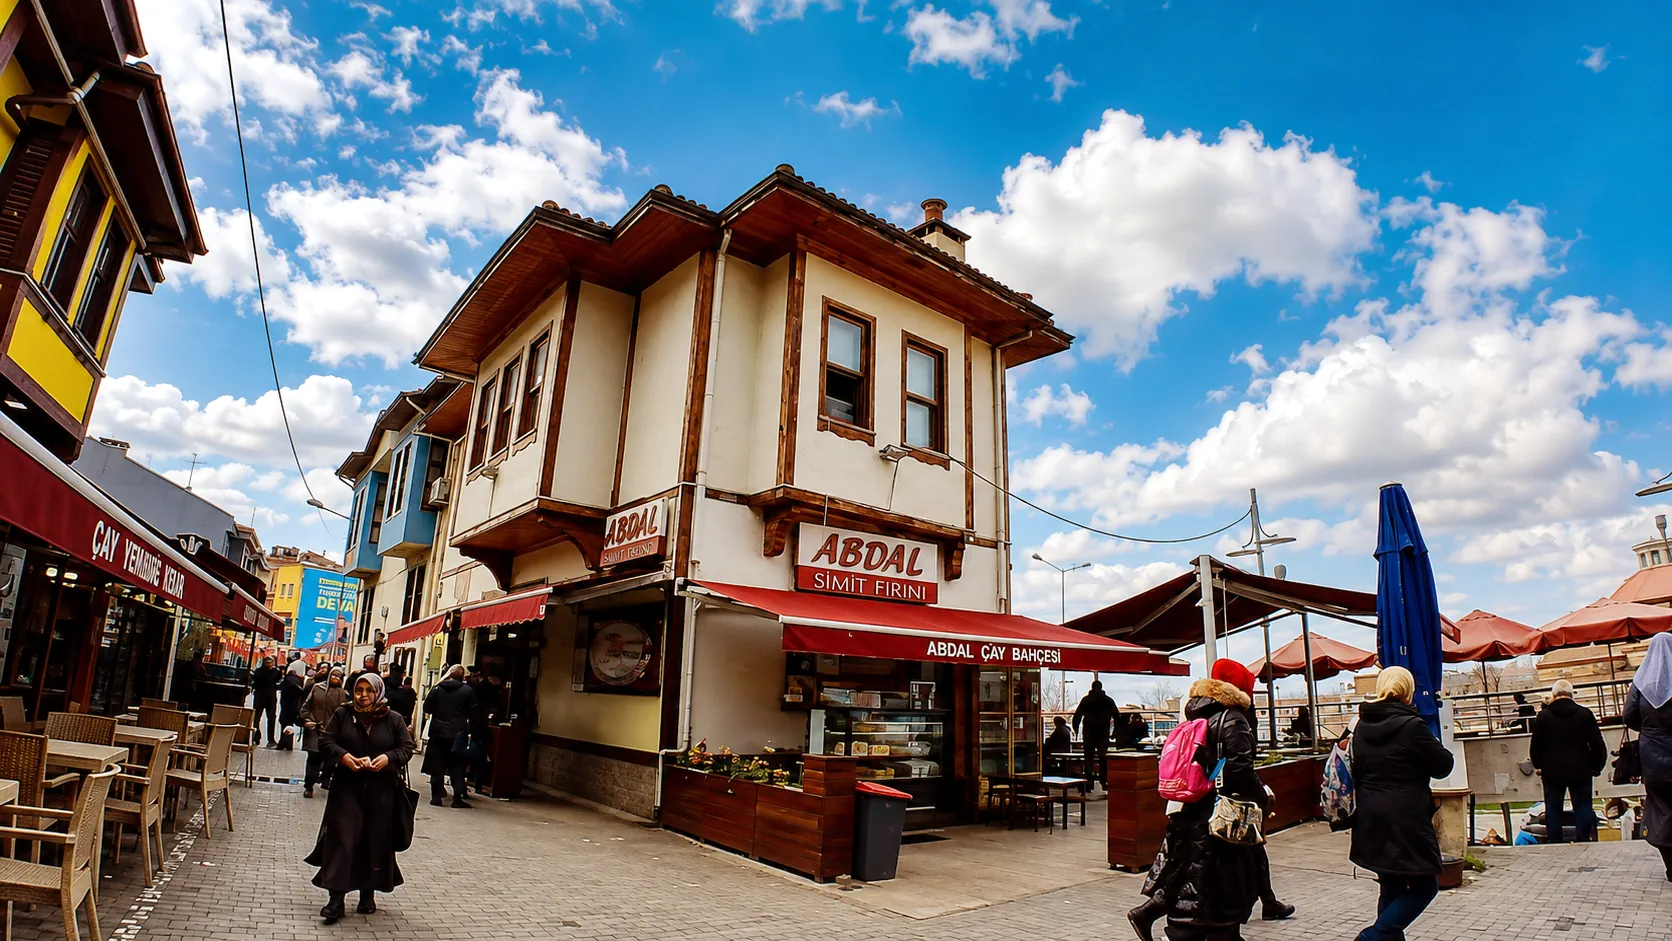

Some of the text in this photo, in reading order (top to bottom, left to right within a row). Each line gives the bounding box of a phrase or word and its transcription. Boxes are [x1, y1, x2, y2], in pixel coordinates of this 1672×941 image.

[92, 520, 120, 562] ÇAY
[604, 505, 658, 548] ABDAL
[811, 533, 923, 577] ABDAL
[814, 571, 926, 601] SİMİT FIRINI
[926, 640, 1061, 665] ABDAL ÇAY BAHÇESİ
